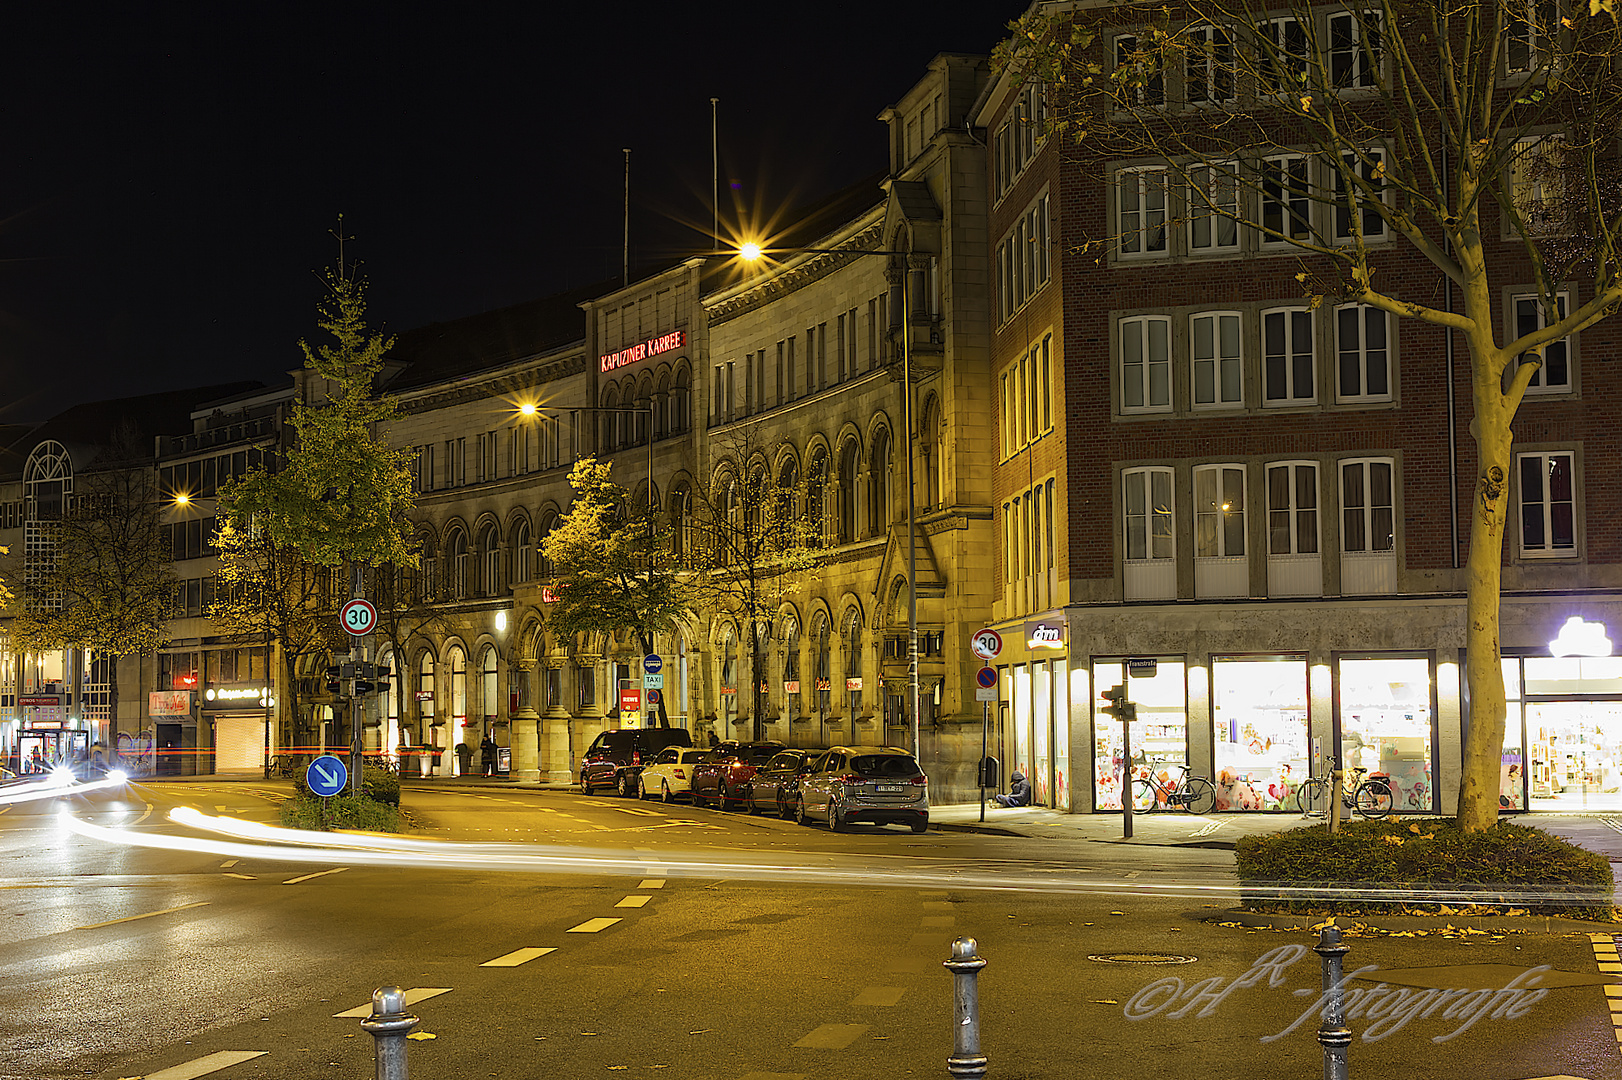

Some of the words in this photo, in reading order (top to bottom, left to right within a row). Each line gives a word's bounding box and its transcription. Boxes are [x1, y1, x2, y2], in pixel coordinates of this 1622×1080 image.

[601, 343, 646, 373] KAPUZINER
[647, 330, 681, 357] KARREE
[348, 610, 368, 625] 30
[1033, 624, 1059, 640] dm
[979, 637, 996, 651] 30
